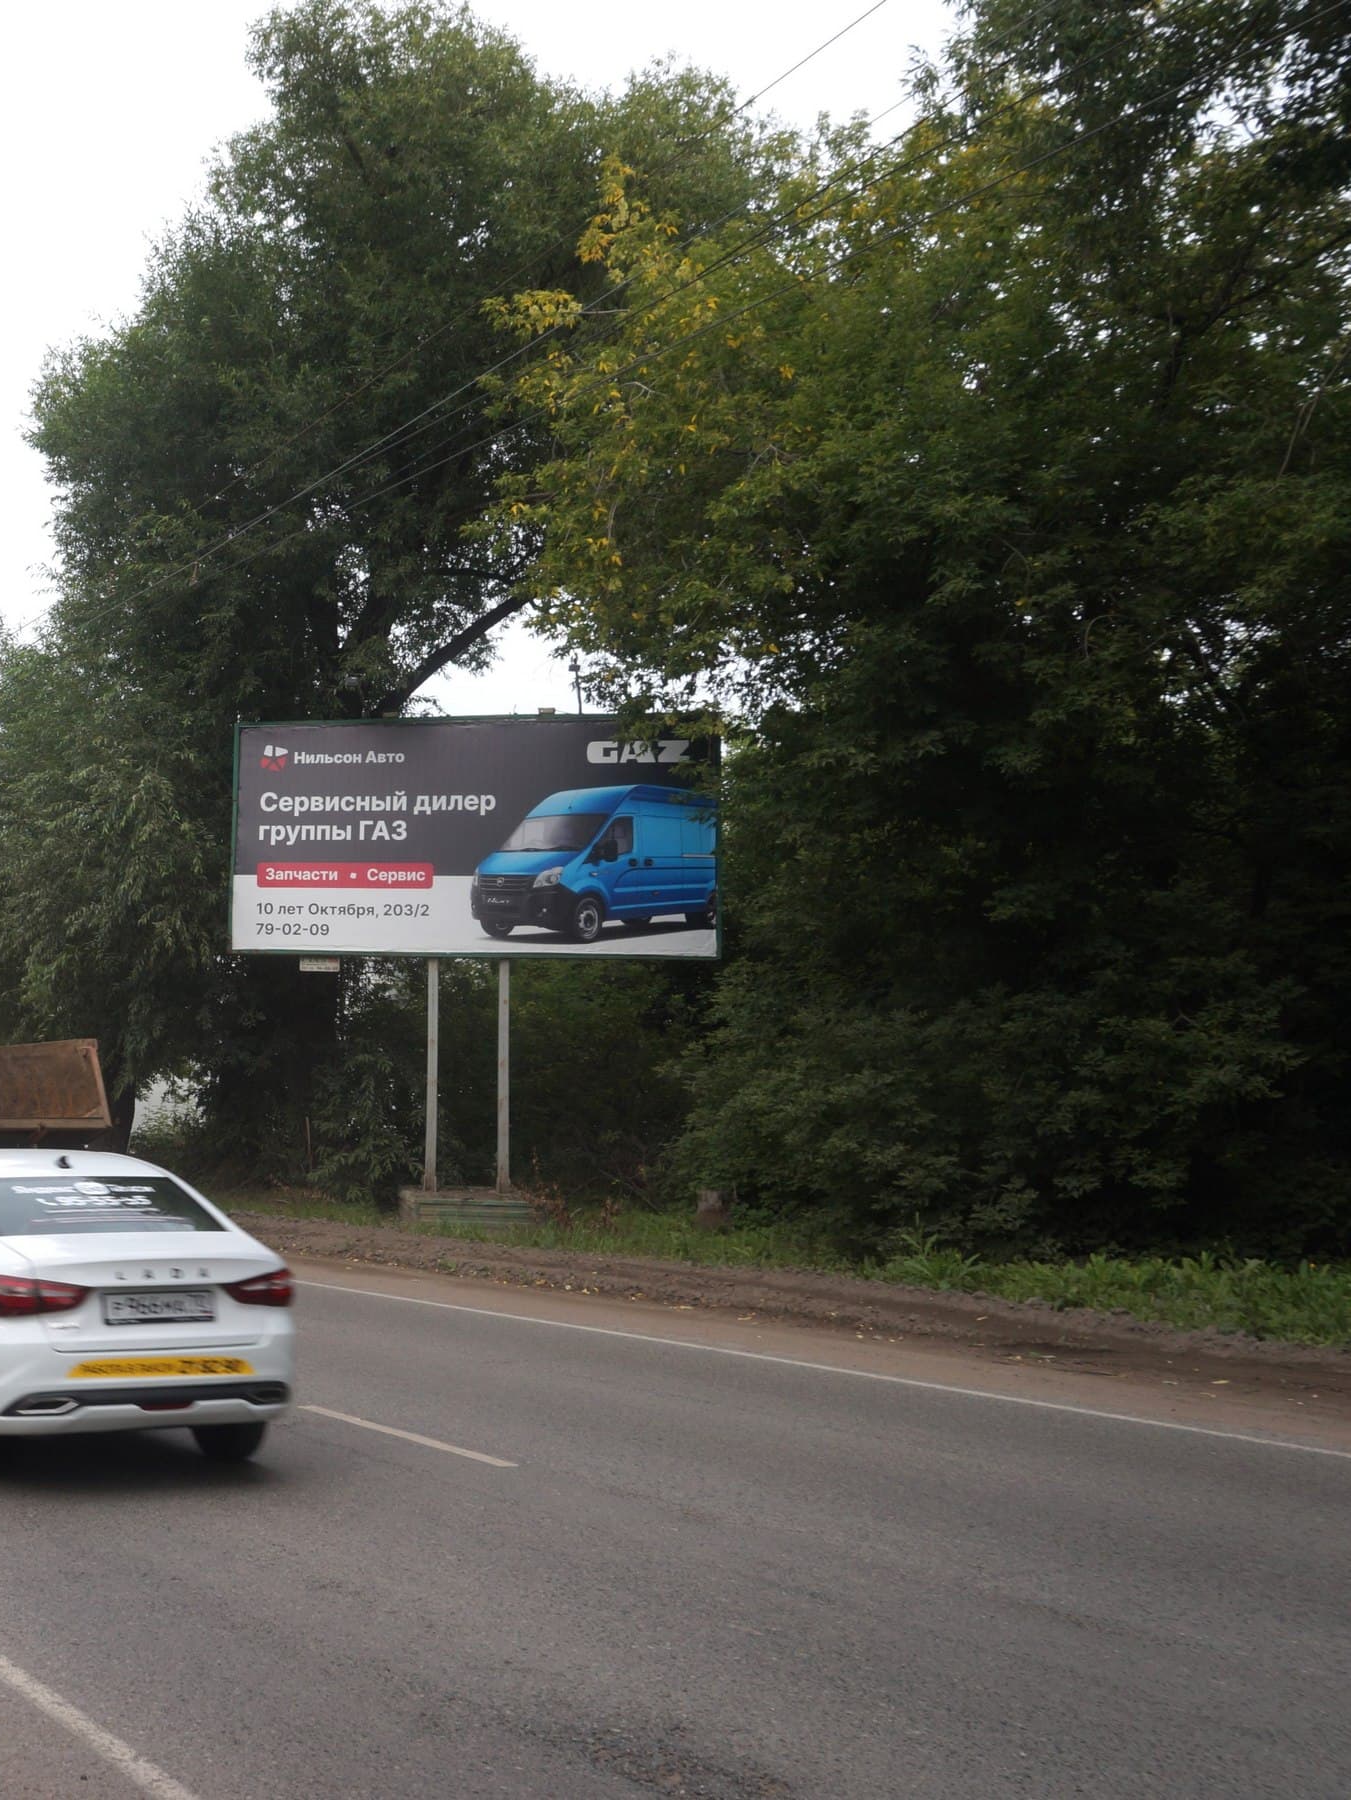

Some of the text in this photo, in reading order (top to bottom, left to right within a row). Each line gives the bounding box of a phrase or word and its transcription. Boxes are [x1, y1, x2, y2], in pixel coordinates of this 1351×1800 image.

[293, 750, 405, 764] Нильсон Авто
[586, 740, 690, 764] GAZ
[259, 790, 497, 817] Сервисный дилер
[258, 820, 408, 846] группы ГАЗ
[265, 867, 426, 884] Запчасти Сервис
[256, 902, 430, 919] 10 лет Октября, 203/2
[256, 922, 330, 936] 79-02-09
